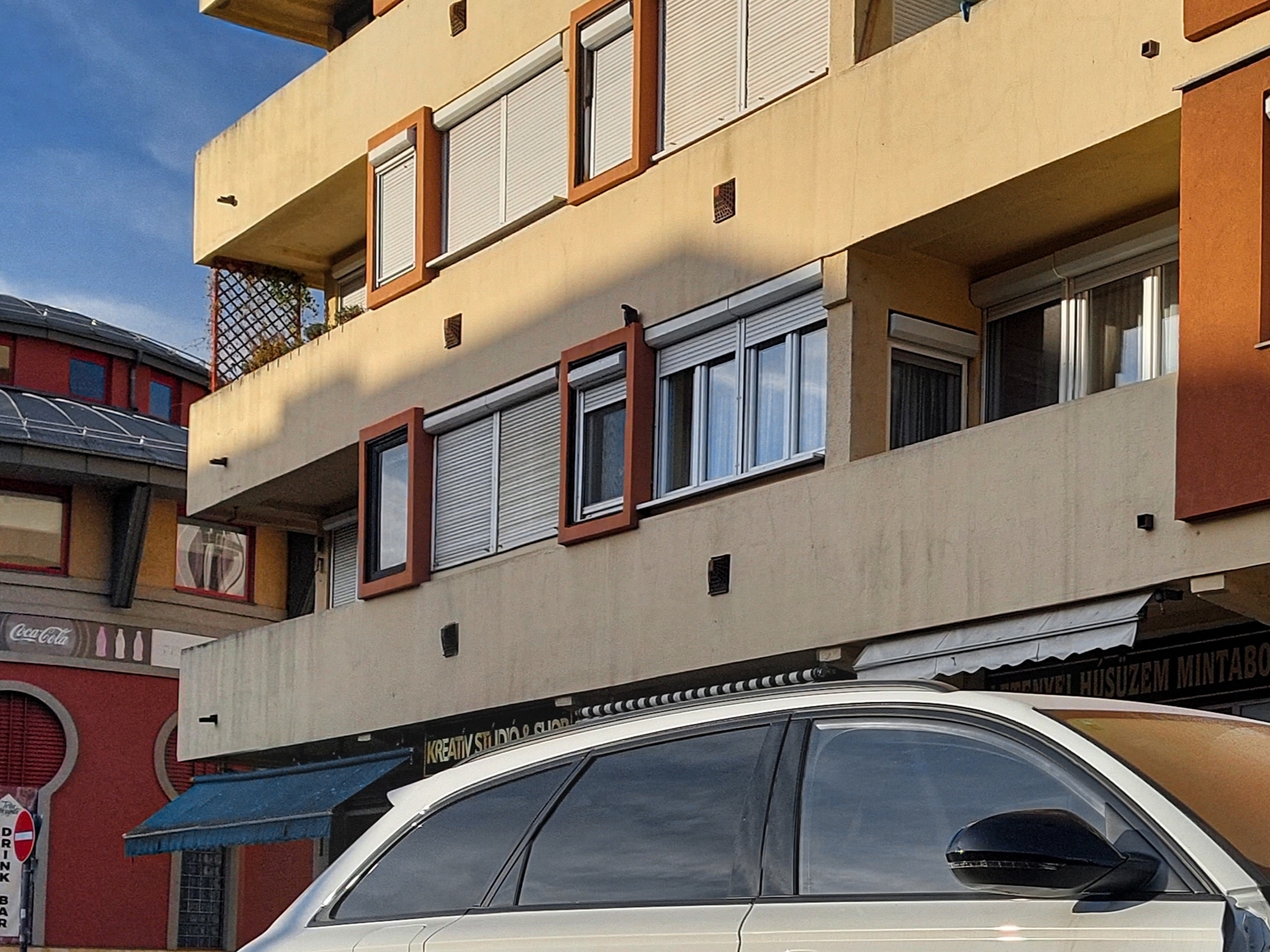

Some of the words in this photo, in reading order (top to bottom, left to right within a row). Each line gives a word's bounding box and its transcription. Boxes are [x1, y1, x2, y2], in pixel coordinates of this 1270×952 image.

[9, 623, 73, 646] Coca-Cola
[1080, 656, 1170, 698] HÚSÜZEM
[426, 728, 474, 765] KREATÍV
[0, 827, 12, 883] DRINK
